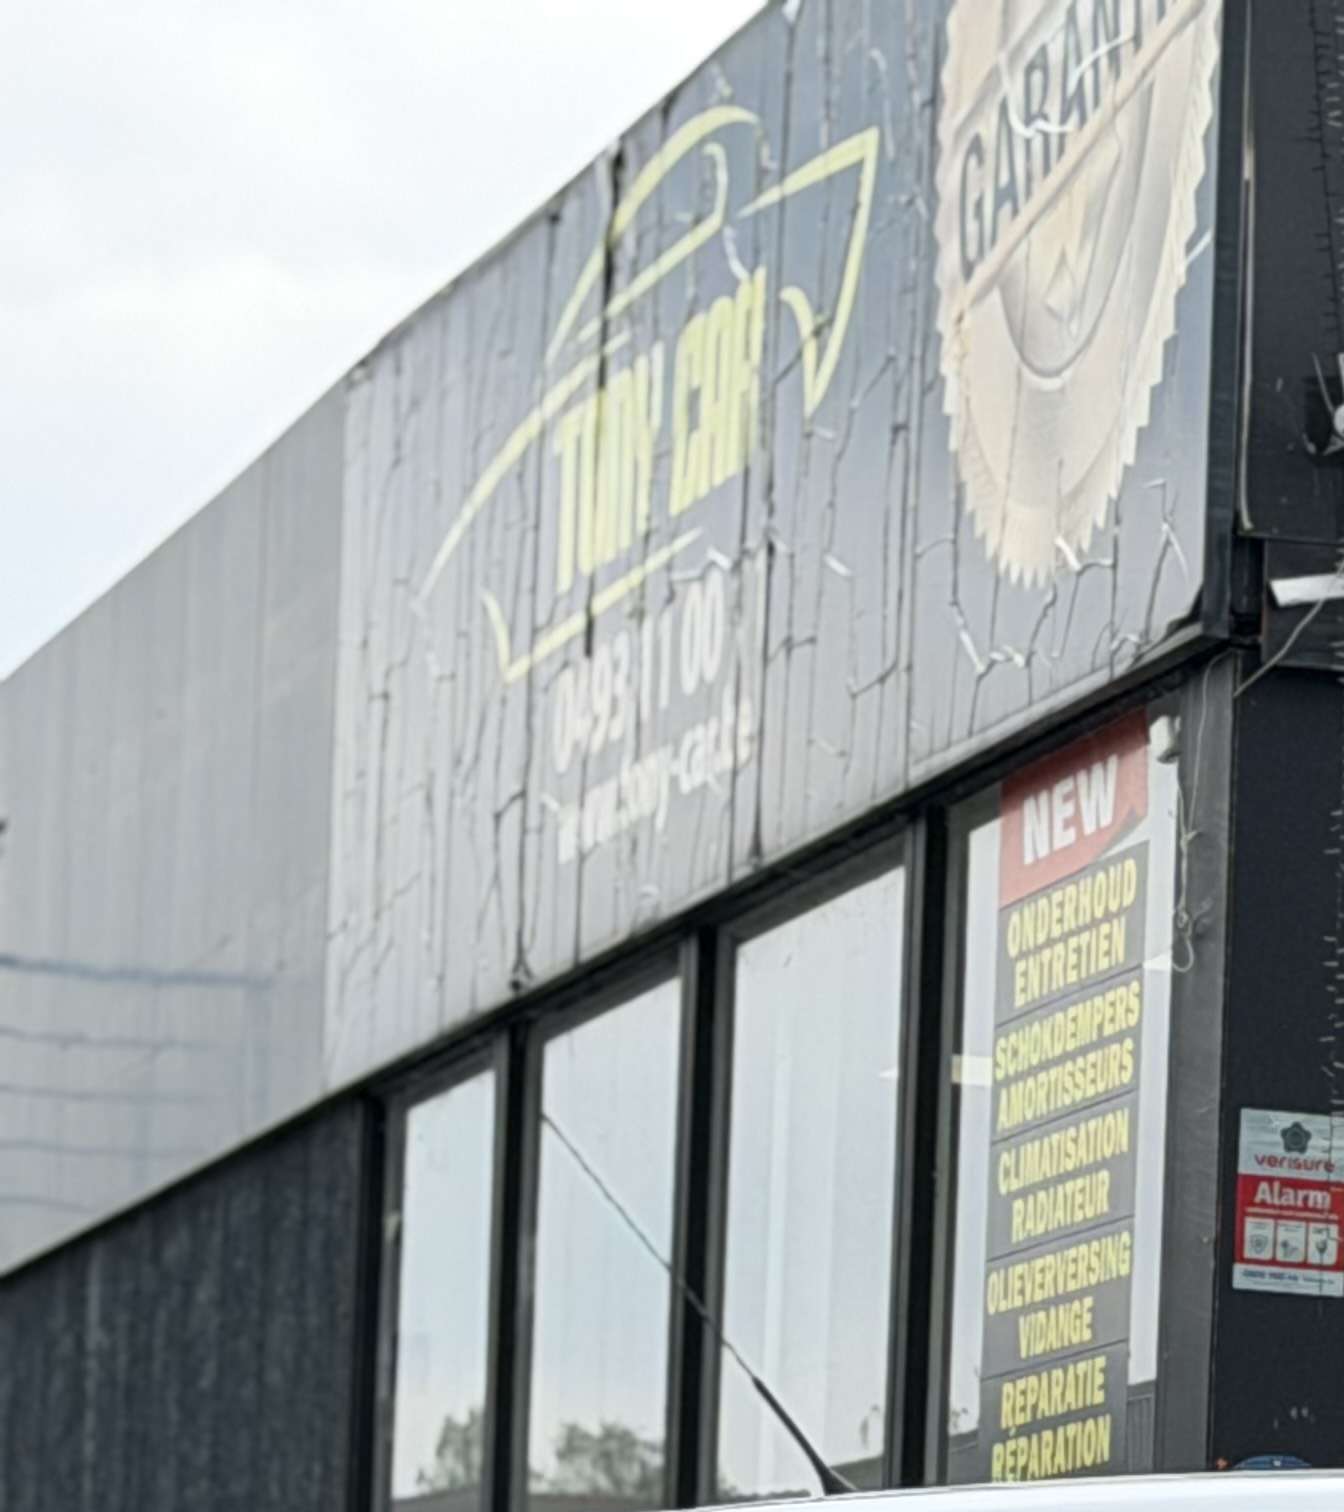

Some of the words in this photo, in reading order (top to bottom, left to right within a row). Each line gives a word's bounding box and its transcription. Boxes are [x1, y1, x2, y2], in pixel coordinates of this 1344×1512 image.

[555, 338, 665, 594] TONY
[668, 264, 767, 518] CAR
[1023, 754, 1118, 865] NEW
[1006, 857, 1138, 959] ONDERHOUD
[1013, 916, 1127, 1008] ENTRETIEN
[995, 979, 1141, 1082] SCHOKDEMPERS
[996, 1037, 1135, 1134] AMORTISSEURS
[998, 1107, 1130, 1197] CLIMATISATION
[1253, 1152, 1337, 1174] verisure
[1253, 1180, 1332, 1211] Alarm
[1011, 1169, 1111, 1244] RADIATEUR
[986, 1230, 1131, 1316] OLIEVERVERSING
[1017, 1295, 1095, 1360] VIDANGE
[1000, 1354, 1107, 1431] REPARATIE
